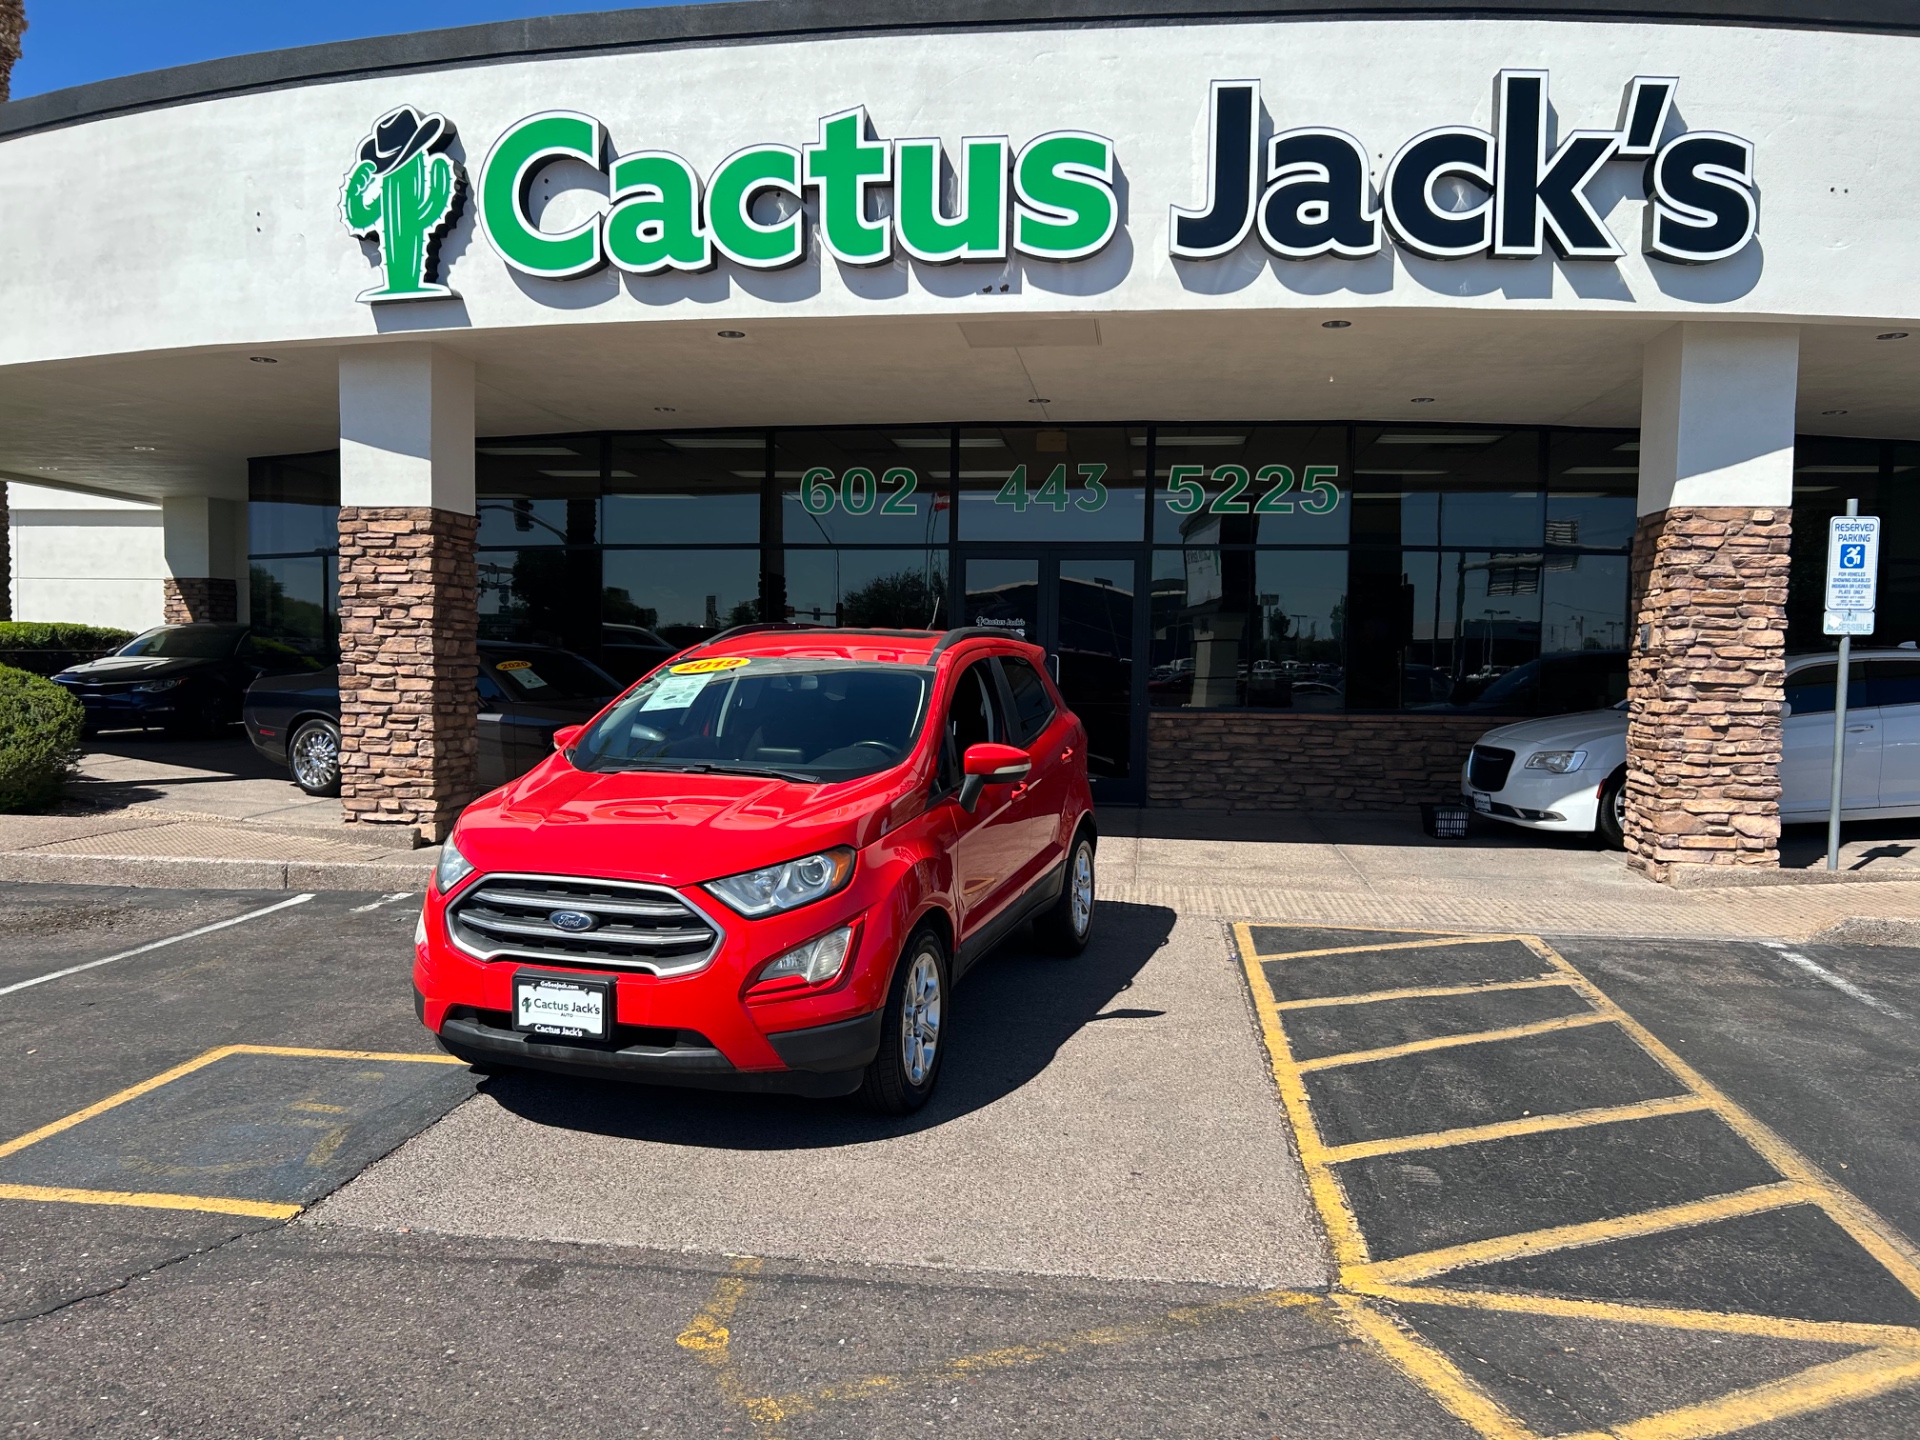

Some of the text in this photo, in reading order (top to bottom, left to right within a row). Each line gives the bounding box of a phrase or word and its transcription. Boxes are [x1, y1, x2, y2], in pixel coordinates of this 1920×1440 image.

[478, 68, 1757, 278] Cactus Jack's
[800, 463, 1340, 515] 602 443 5225
[1834, 523, 1875, 532] RESERVED
[1838, 533, 1871, 542] PARKING
[1842, 613, 1857, 622] VAN
[500, 662, 528, 670] 2020
[678, 660, 741, 672] 2019
[557, 914, 582, 927] Ford
[534, 998, 600, 1014] Cactus Jack's
[535, 1024, 583, 1037] Cactus Jack's
